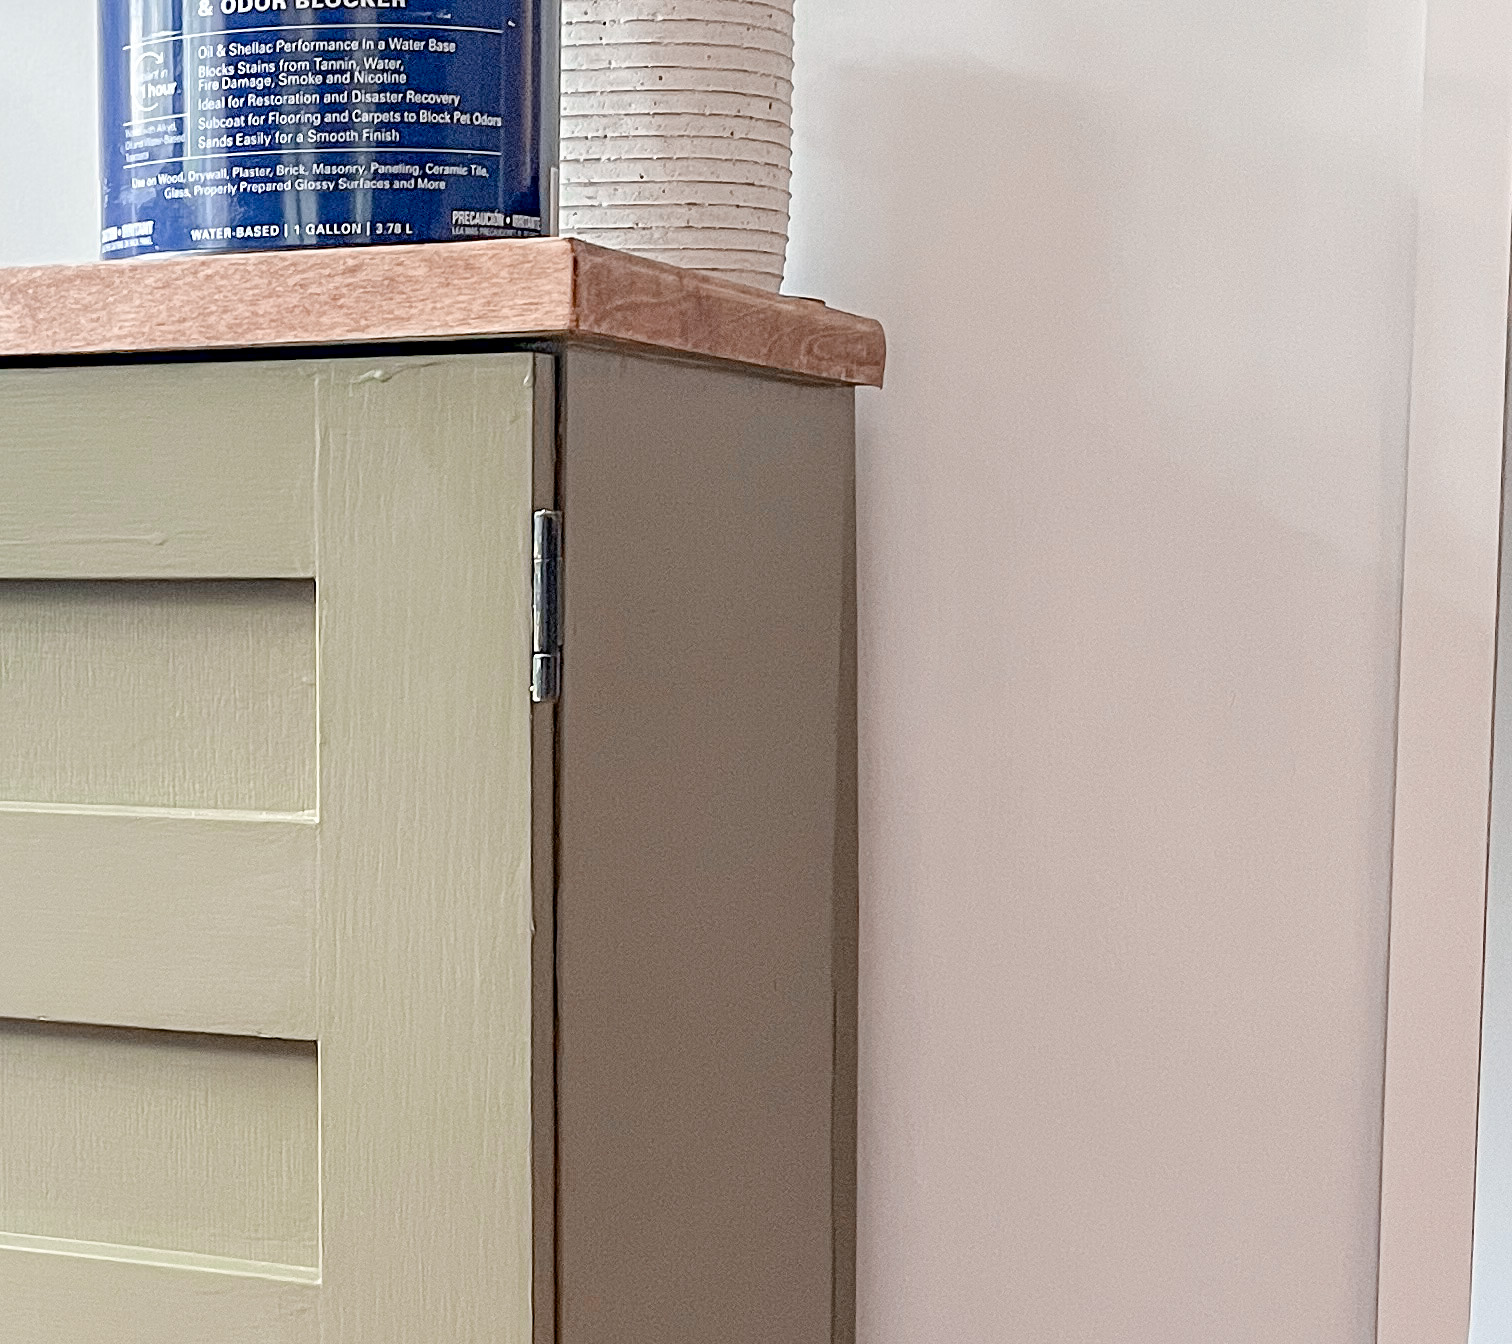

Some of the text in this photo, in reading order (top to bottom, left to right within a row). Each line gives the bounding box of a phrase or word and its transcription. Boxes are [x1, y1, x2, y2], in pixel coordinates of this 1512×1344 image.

[198, 0, 213, 17] &
[198, 45, 213, 59] Oil
[216, 43, 226, 57] &
[229, 41, 273, 56] Shellac
[276, 38, 358, 53] Performance
[378, 40, 386, 51] a
[389, 38, 426, 51] Water
[428, 38, 457, 52] Base
[198, 57, 405, 79] Blocks Stains from Tannin, Water,
[198, 70, 407, 91] Fire Damage, Smoke and Nicotine
[198, 89, 461, 110] Ideal for Restoration and Disaster Recovery
[197, 109, 502, 131] Subcoat for Flooring and Carpets to Block Pet Odors
[197, 128, 400, 149] Sands Easily for a Smooth Finish
[157, 172, 186, 185] Wood,
[188, 168, 230, 183] Drywall,
[232, 166, 274, 179] Plaster,
[370, 162, 423, 176] Paneling,
[425, 163, 468, 176] Ceramic
[470, 164, 489, 179] Tile,
[194, 184, 238, 197] Properly
[239, 180, 292, 194] Prepared
[295, 178, 335, 191] Glossy
[338, 177, 390, 190] Surfaces
[392, 177, 415, 189] and
[417, 179, 446, 190] More
[190, 225, 280, 241] WATER-BASED
[294, 225, 300, 235] 1
[305, 223, 362, 235] GALLON
[405, 223, 413, 234] L
